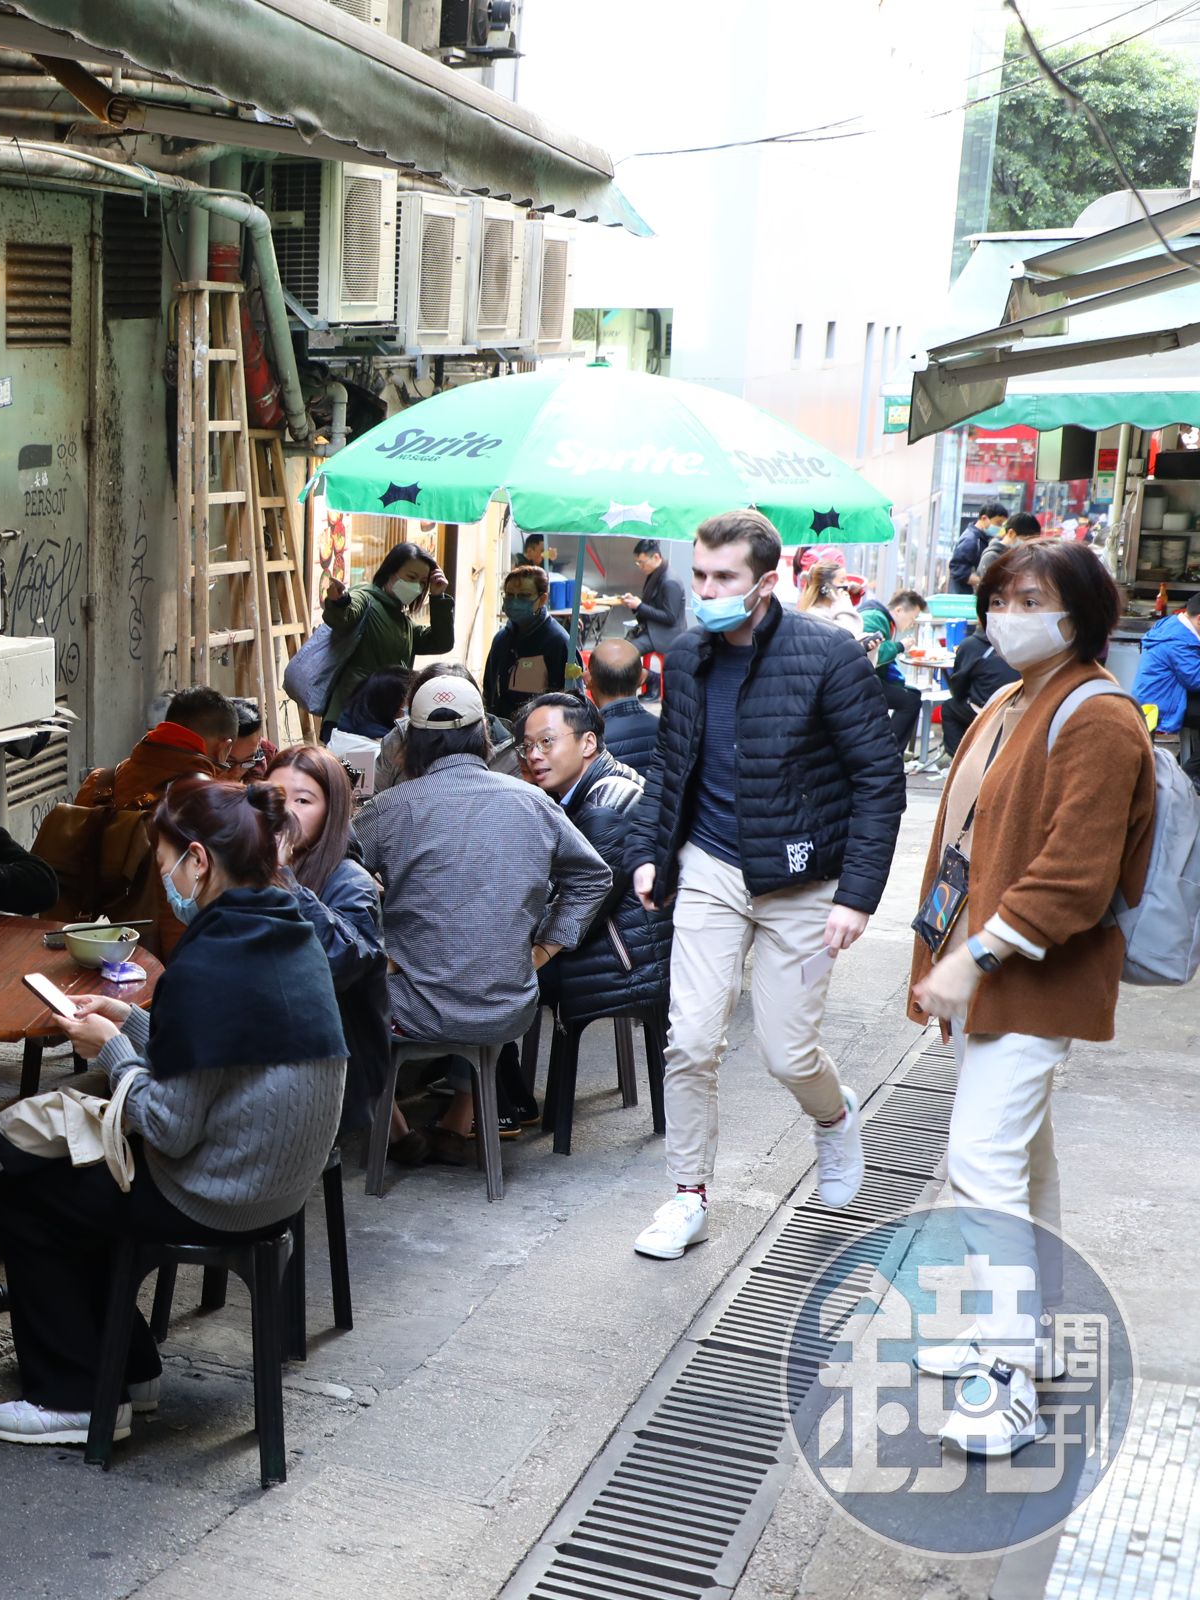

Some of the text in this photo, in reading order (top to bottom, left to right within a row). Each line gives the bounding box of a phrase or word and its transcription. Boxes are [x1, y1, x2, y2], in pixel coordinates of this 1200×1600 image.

[375, 428, 503, 459] Sprite
[548, 440, 705, 476] Sprite
[734, 449, 832, 485] Sprite
[24, 487, 67, 517] PERSON
[786, 840, 814, 856] RICH
[788, 852, 808, 864] MO
[789, 862, 806, 873] ND
